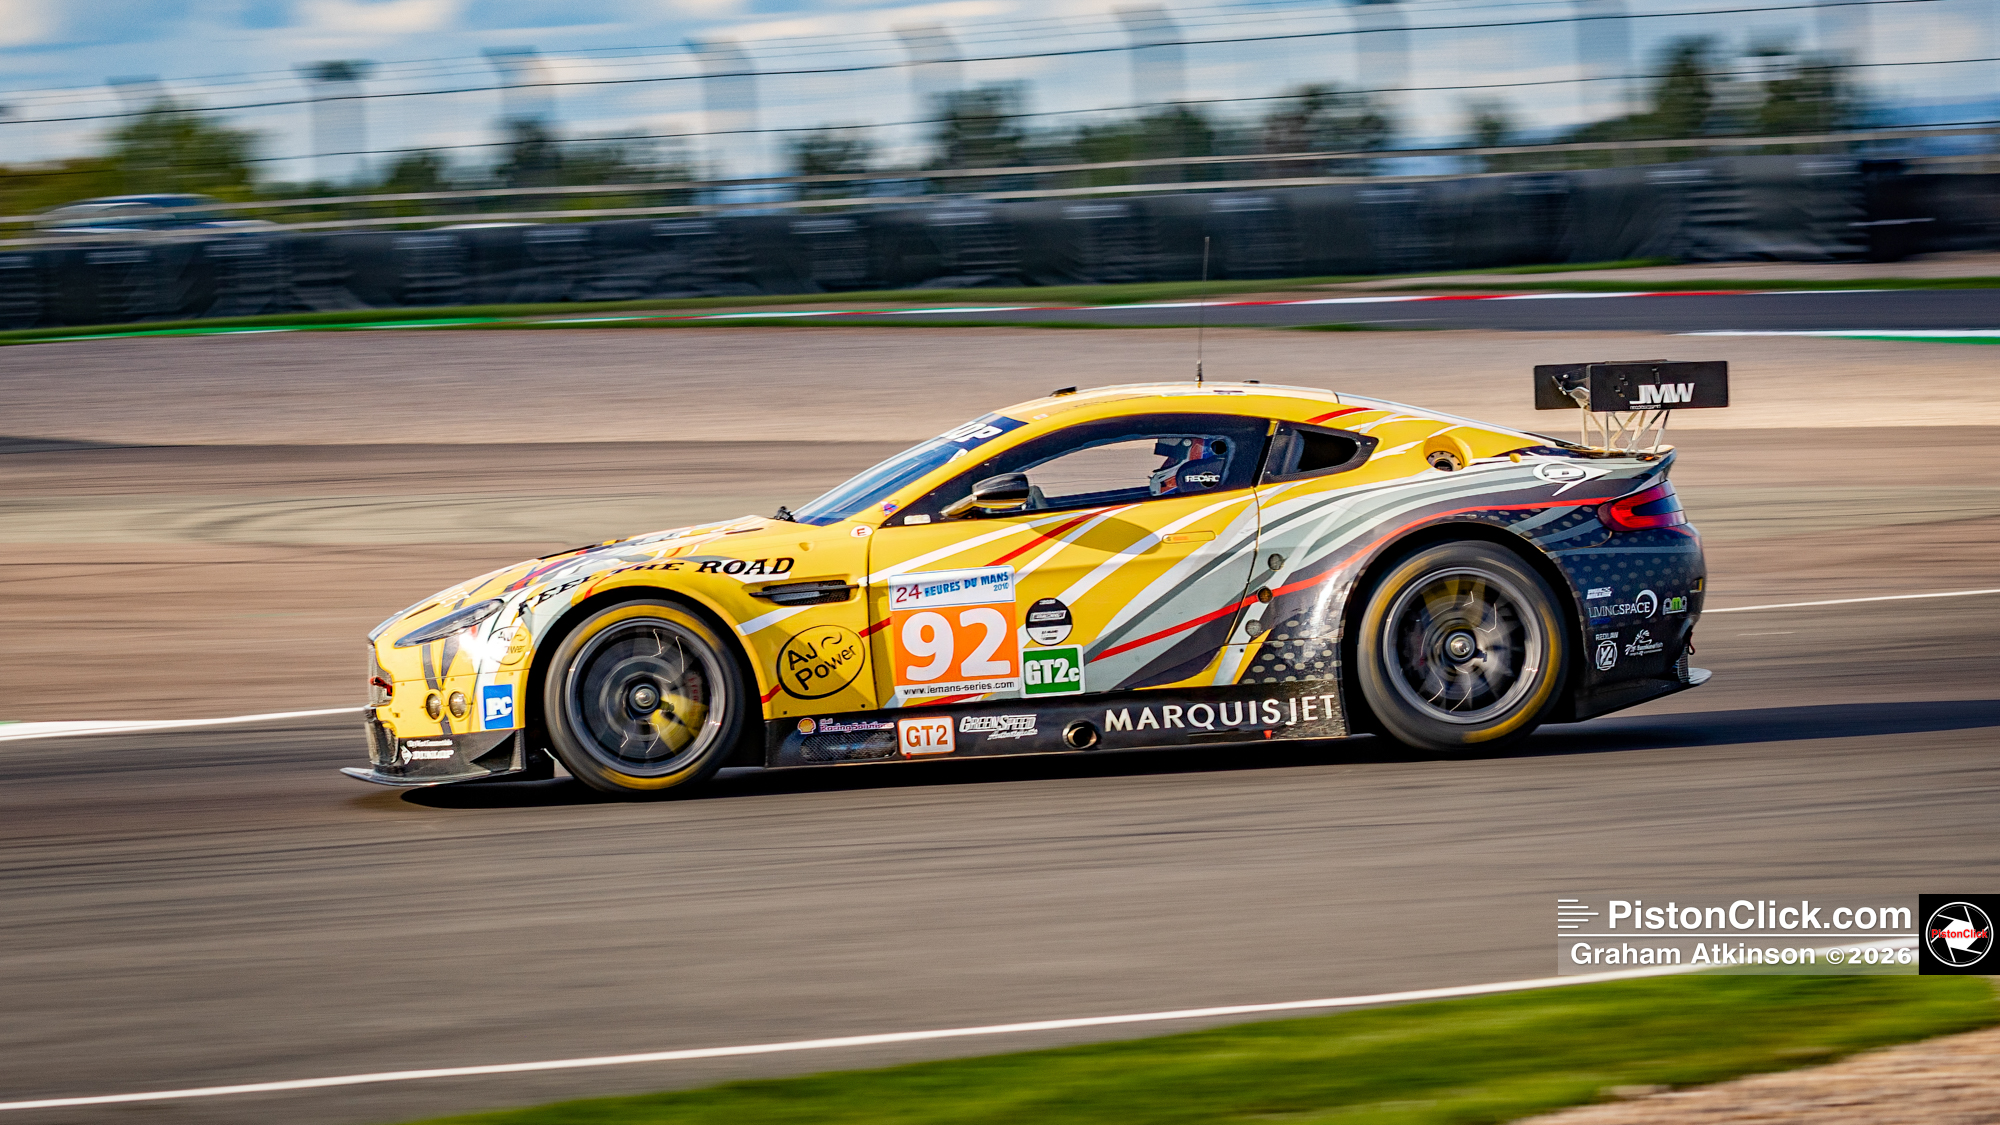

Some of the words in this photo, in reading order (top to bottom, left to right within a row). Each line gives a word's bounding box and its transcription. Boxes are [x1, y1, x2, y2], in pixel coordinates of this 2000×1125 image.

[1629, 382, 1695, 404] JMW
[857, 528, 865, 536] E
[612, 562, 684, 574] THE
[696, 557, 795, 575] ROAD
[895, 584, 922, 603] 24
[924, 581, 960, 597] HEURES
[964, 577, 978, 589] DU
[980, 571, 1009, 585] MANS
[993, 583, 1009, 592] 2010
[902, 607, 1011, 681] 92
[788, 642, 818, 671] AJ
[794, 645, 857, 691] Power
[1025, 658, 1080, 685] GT2c
[903, 681, 1015, 695] www.lemans-series.com
[906, 725, 948, 747] GT2
